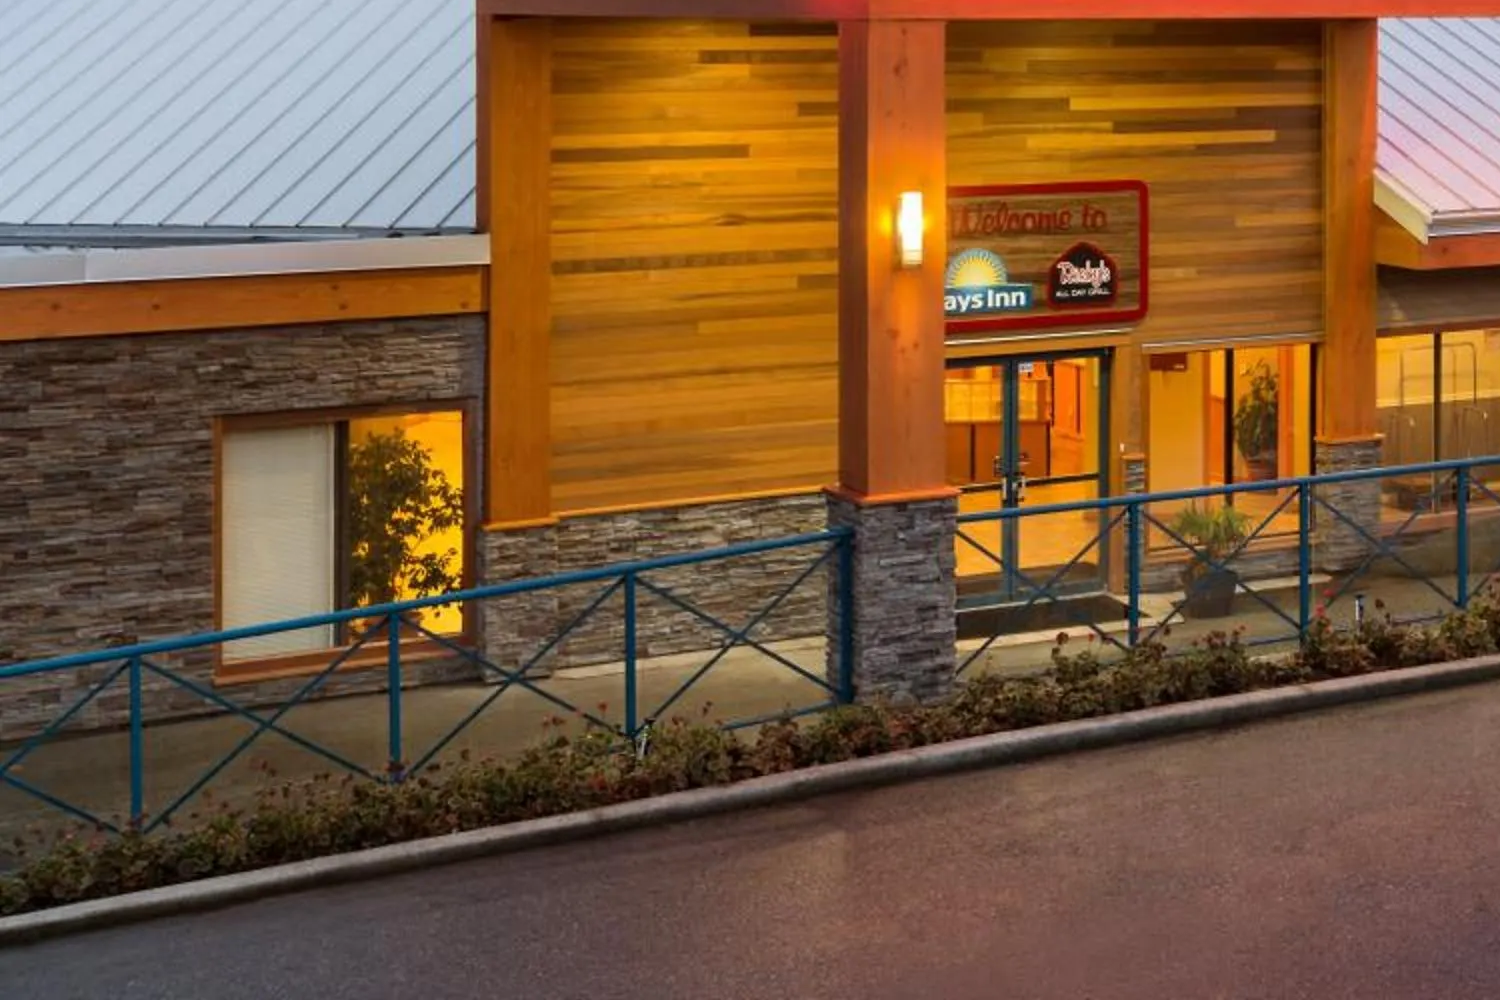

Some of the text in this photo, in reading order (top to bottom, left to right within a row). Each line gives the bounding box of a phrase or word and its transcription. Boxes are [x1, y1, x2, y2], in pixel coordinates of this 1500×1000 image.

[1082, 203, 1108, 230] to
[944, 289, 1026, 313] ays Inn
